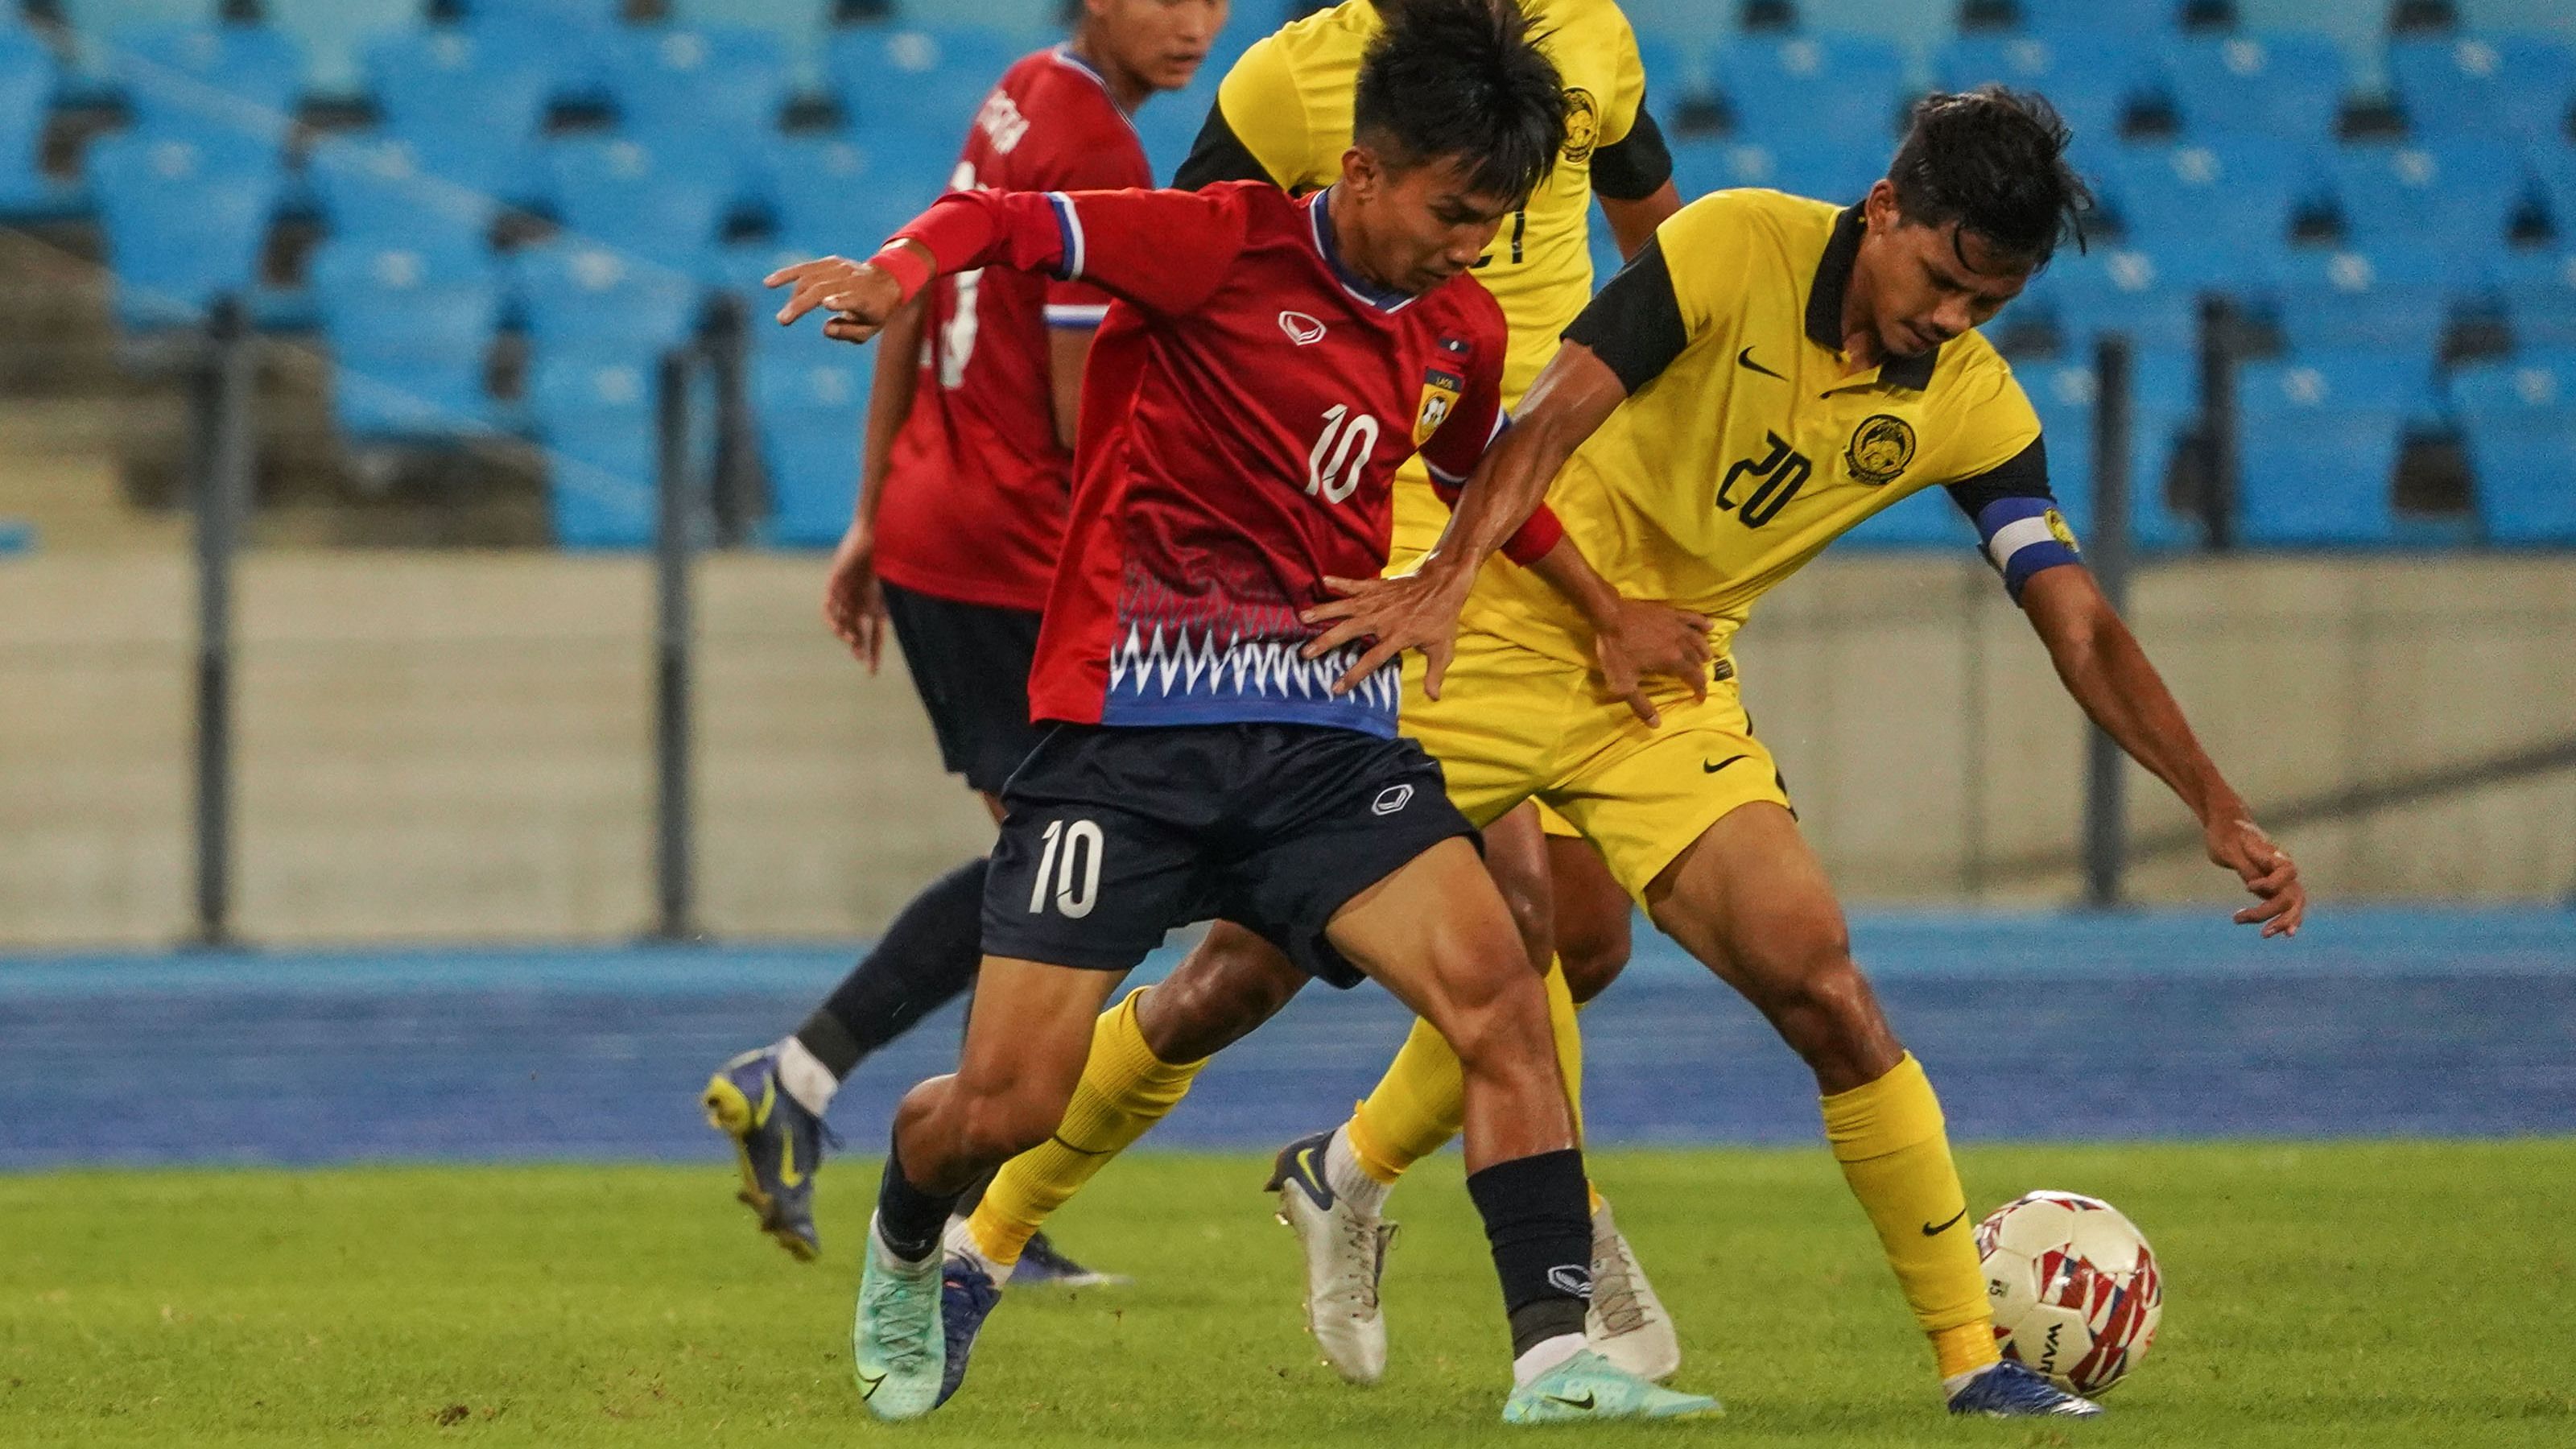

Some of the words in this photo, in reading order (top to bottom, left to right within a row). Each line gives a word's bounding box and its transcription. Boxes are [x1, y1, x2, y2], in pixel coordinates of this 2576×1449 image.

[1305, 403, 1379, 505] 10
[1715, 429, 1812, 529] 20
[1029, 819, 1103, 919] 10
